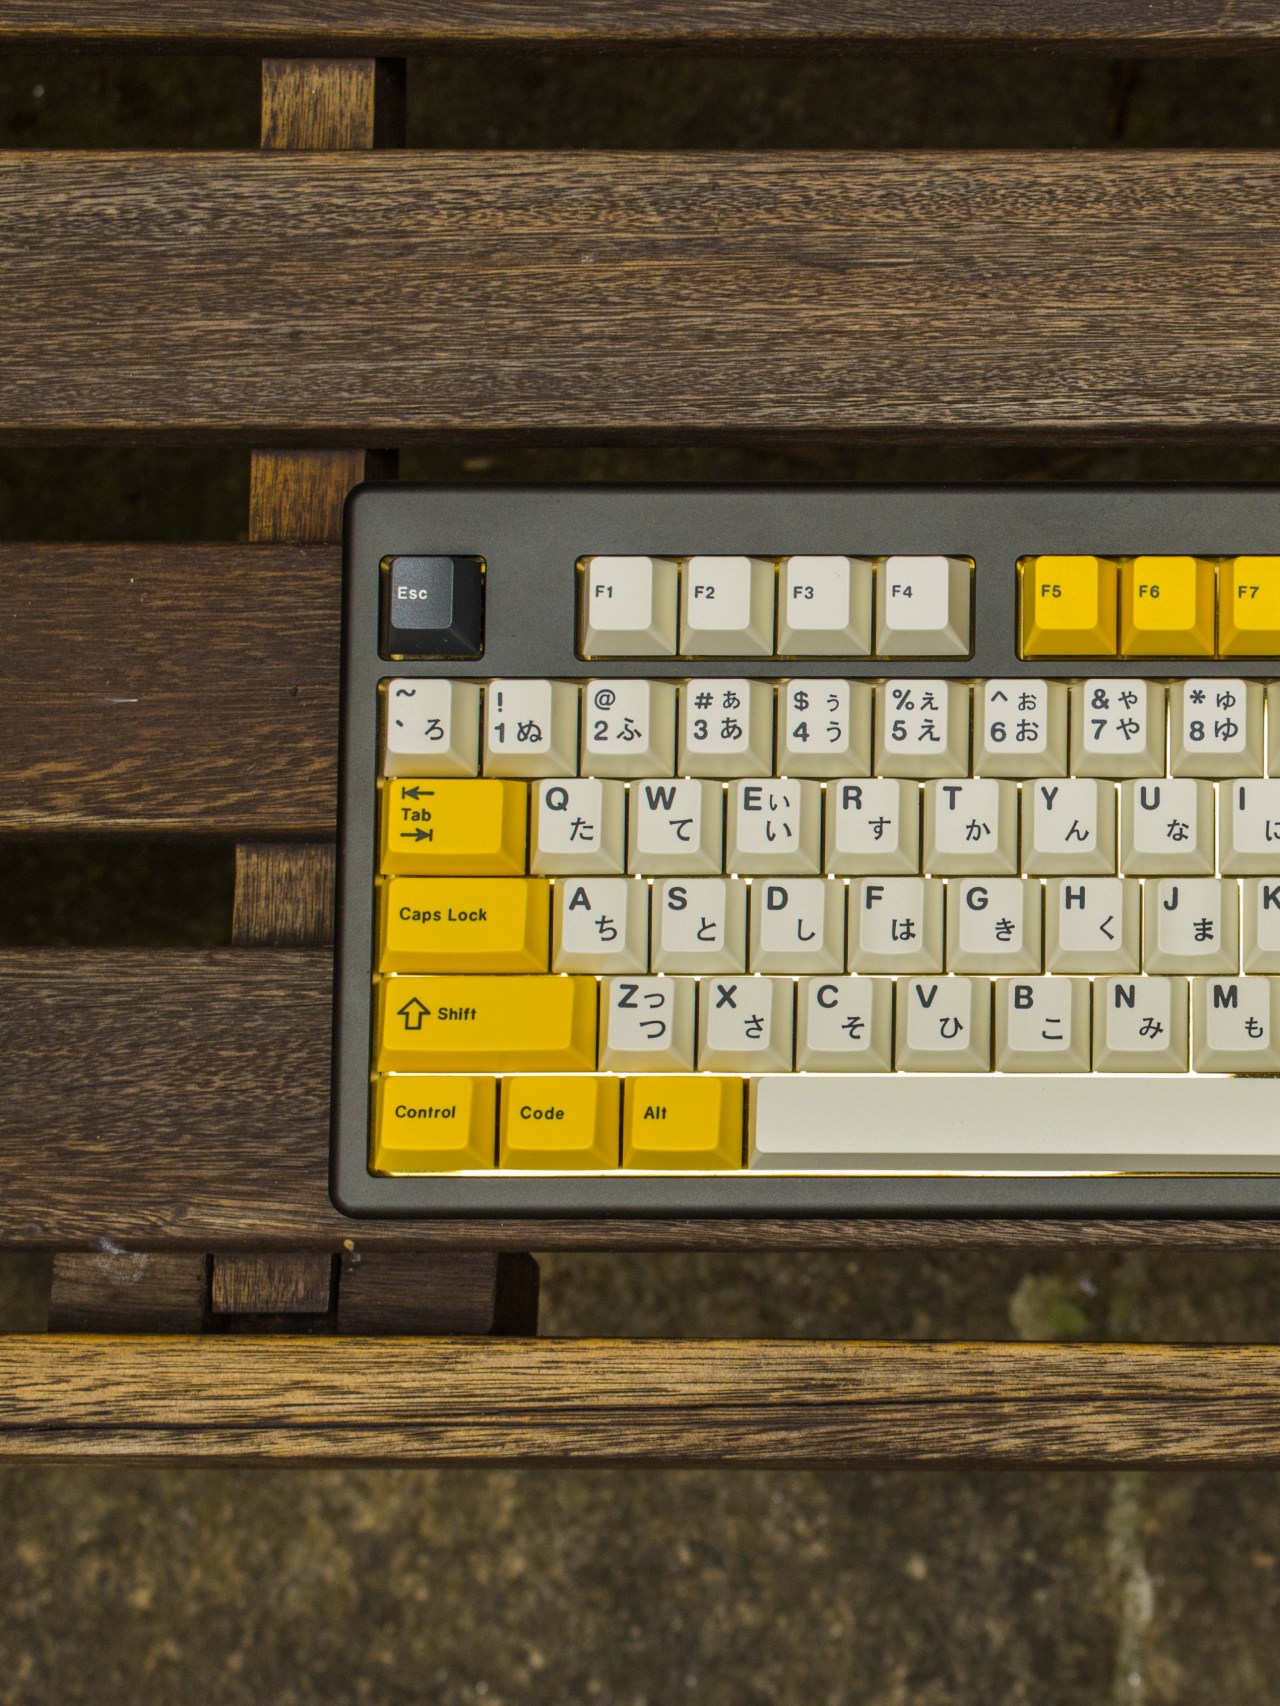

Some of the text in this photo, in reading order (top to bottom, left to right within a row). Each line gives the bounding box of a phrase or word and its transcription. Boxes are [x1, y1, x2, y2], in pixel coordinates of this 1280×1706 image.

[397, 586, 428, 601] Esc
[595, 584, 613, 599] F1
[694, 585, 715, 600] F2
[793, 585, 814, 600] F3
[892, 584, 913, 599] F4
[1041, 584, 1062, 598] F5
[1139, 585, 1160, 599] F6
[1238, 585, 1259, 598] F7
[497, 691, 503, 713] !
[594, 688, 616, 711] @
[694, 692, 714, 710] #
[793, 690, 810, 712] $
[892, 688, 915, 711] %
[1091, 688, 1110, 710] &
[424, 718, 445, 741] ろ
[494, 719, 543, 744] 1 ぬ
[593, 717, 642, 742] 2 ふ
[693, 716, 743, 741] 3 あ
[792, 720, 842, 743] 4 う
[891, 718, 941, 742] 5 え
[990, 718, 1039, 743] 6 お
[1090, 717, 1140, 741] 7 や
[1189, 717, 1239, 742] 8 ゆ
[545, 786, 569, 812] Q
[645, 785, 677, 811] W
[743, 786, 763, 811] E
[842, 785, 863, 810] R
[942, 785, 963, 811] T
[1040, 786, 1059, 811] Y
[1140, 786, 1161, 811] U
[401, 807, 432, 822] Tab
[569, 817, 594, 841] た
[668, 818, 694, 842] て
[766, 820, 792, 842] い
[868, 816, 892, 841] す
[965, 818, 991, 841] か
[1064, 819, 1090, 842] ん
[1166, 819, 1190, 842] な
[568, 886, 592, 911] A
[667, 886, 688, 911] S
[766, 886, 789, 911] D
[865, 885, 885, 910] F
[966, 886, 989, 911] G
[1065, 885, 1086, 910] H
[1163, 886, 1179, 911] J
[399, 907, 487, 924] Caps Lock
[594, 915, 618, 942] ち
[696, 917, 717, 942] と
[797, 918, 816, 942] し
[891, 918, 916, 942] は
[995, 917, 1016, 942] き
[1099, 915, 1115, 941] く
[1193, 917, 1214, 942] ま
[617, 983, 640, 1009] Z
[715, 984, 738, 1009] X
[816, 984, 839, 1009] C
[915, 984, 939, 1009] V
[1014, 984, 1034, 1010] B
[1114, 983, 1136, 1009] N
[1213, 984, 1238, 1009] M
[437, 1007, 477, 1021] Shift
[639, 1020, 666, 1039] つ
[743, 1014, 765, 1039] さ
[841, 1016, 865, 1040] そ
[939, 1017, 964, 1039] ひ
[1041, 1017, 1063, 1040] こ
[1138, 1017, 1164, 1040] み
[1244, 1016, 1264, 1039] も
[394, 1105, 456, 1119] Control
[520, 1105, 565, 1120] Code
[643, 1106, 667, 1120] Alt
